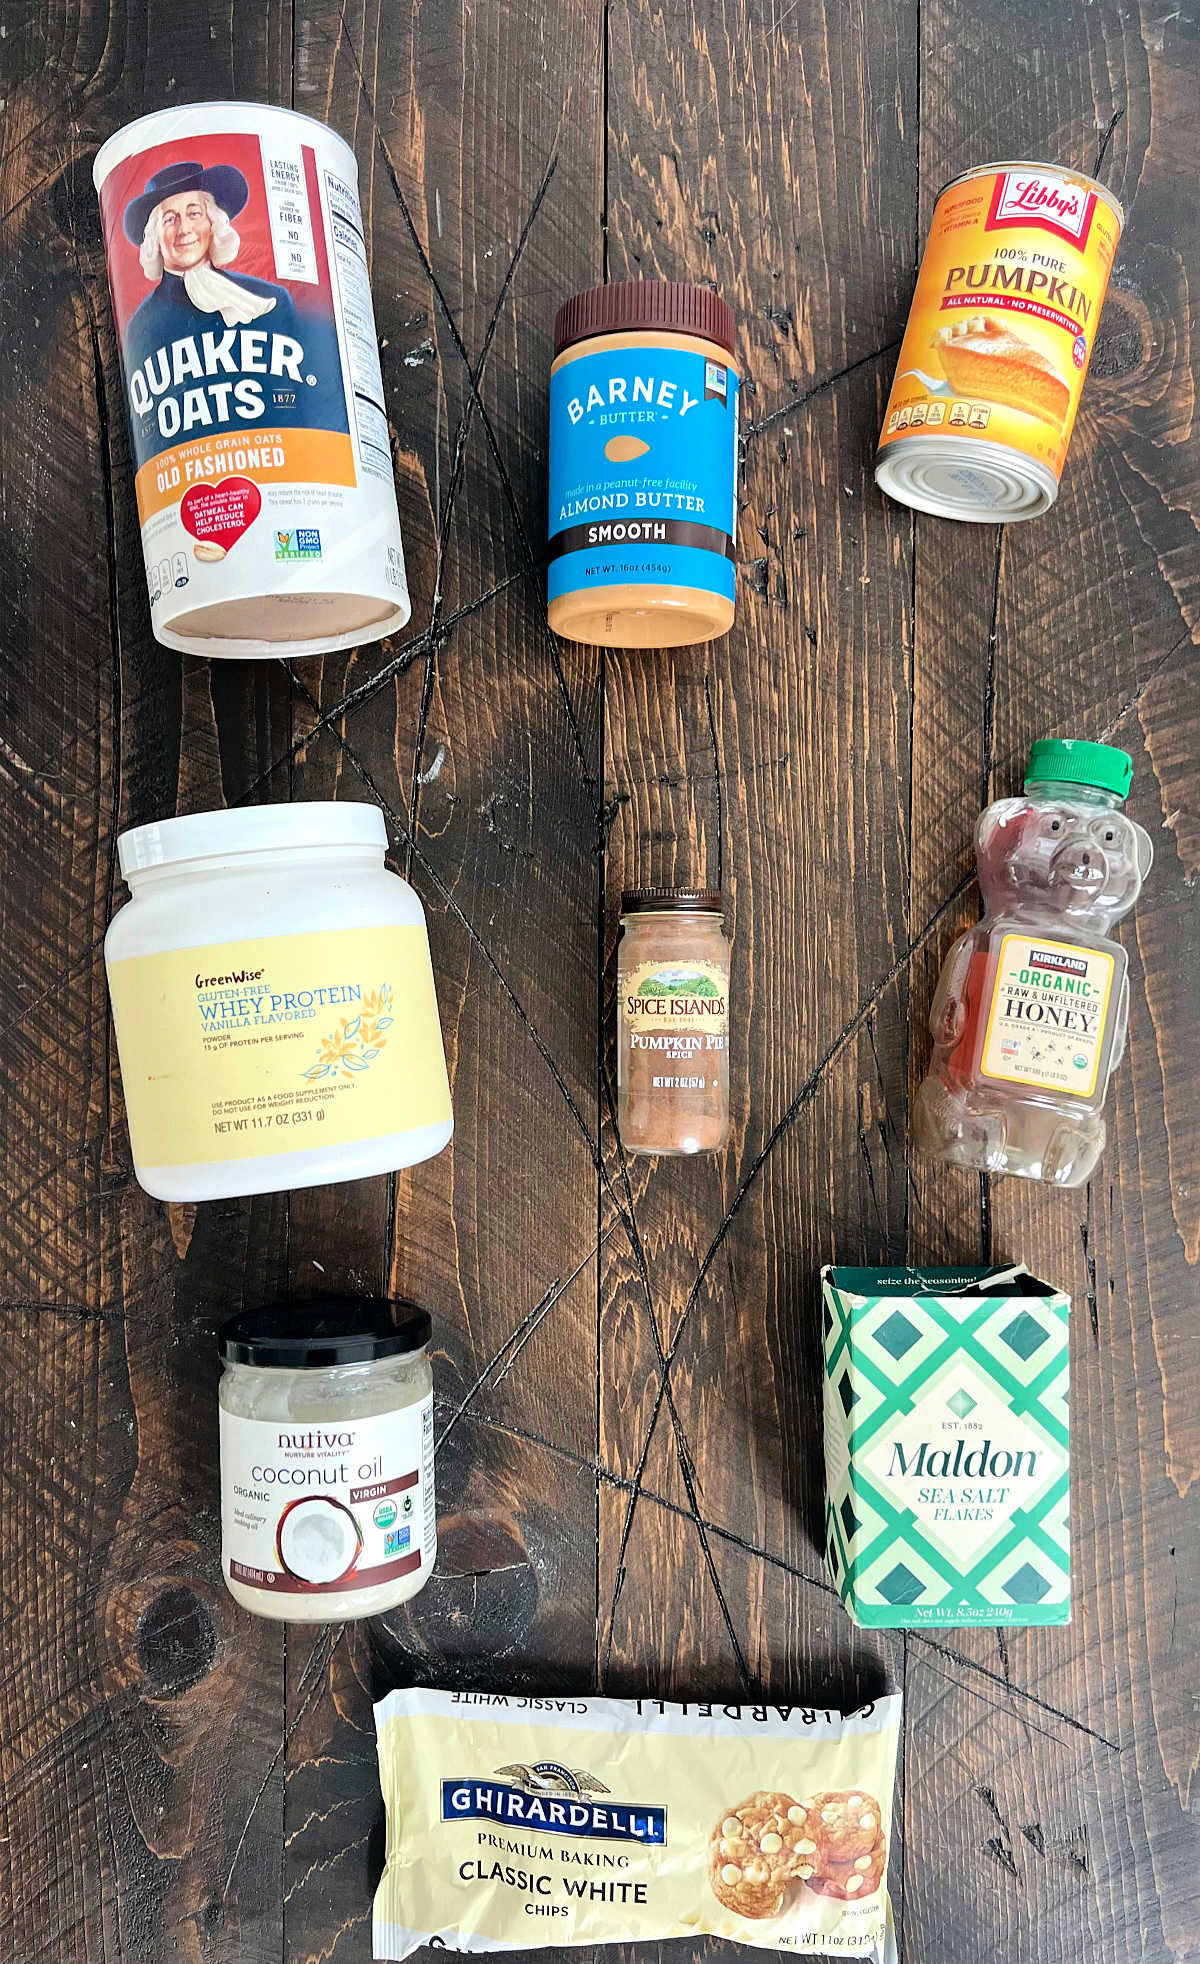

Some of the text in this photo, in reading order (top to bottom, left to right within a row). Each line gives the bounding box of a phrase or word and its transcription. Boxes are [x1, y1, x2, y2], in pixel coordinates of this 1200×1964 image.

[270, 160, 299, 173] LASTING
[271, 169, 300, 183] ENERGY
[1005, 180, 1079, 218] Libby's
[280, 212, 302, 225] FIBER
[288, 230, 299, 241] NO
[291, 253, 302, 263] NO
[994, 247, 1067, 274] 100% PURE
[944, 264, 1092, 324] PUMPKIN
[947, 295, 1080, 335] ALL NATURAL NO PRESERVATIVES
[130, 329, 304, 419] QUAKER
[157, 379, 266, 438] OATS
[272, 393, 297, 405] 1877
[567, 376, 699, 425] BARNEY
[600, 410, 656, 426] BUTTER
[155, 433, 283, 470] 100% WHOLE GRAIN OATS
[157, 447, 285, 493] OLD FASHIONED
[586, 482, 595, 493] in
[596, 482, 602, 491] a
[602, 477, 663, 492] peanut-free
[664, 478, 698, 492] facility
[194, 502, 244, 519] OATMEAL CAN
[559, 492, 705, 520] ALMOND BUTTER
[195, 511, 245, 529] HELP REDUCE
[196, 519, 246, 536] CHOLESTEROL
[298, 530, 318, 538] NON
[299, 537, 320, 545] GMO
[588, 523, 666, 543] SMOOTH
[585, 566, 600, 576] NET
[620, 564, 639, 572] 16oz
[641, 563, 672, 574] (454g)
[1032, 951, 1087, 971] KIRKLAND
[195, 969, 262, 989] GreenWise
[1019, 969, 1092, 998] ORGANIC
[197, 984, 271, 1003] GLUTEN-FREE
[198, 984, 362, 1021] WHEY PROTEIN
[1007, 986, 1099, 1013] RAW & UNFILTERED
[627, 996, 725, 1015] SPICE ISLANDS
[201, 1008, 317, 1032] VANILLA FLAVORED
[1004, 998, 1096, 1034] HONEY
[202, 1034, 231, 1044] POWDER
[230, 1039, 259, 1048] PROTEIN
[275, 1031, 305, 1042] SERVING
[630, 1034, 724, 1050] PUMPKIN PIE
[666, 1050, 693, 1059] SPICE
[652, 1076, 663, 1088] NET
[664, 1076, 674, 1088] WT
[211, 1101, 223, 1109] USE
[225, 1097, 255, 1107] PRODUCT
[273, 1092, 294, 1100] FOOD
[295, 1085, 337, 1097] SUPPLEMENT
[239, 1105, 252, 1113] USE
[268, 1099, 294, 1108] WEIGHT
[214, 1108, 325, 1134] NET WT 11.7 OZ (331 g)
[877, 1277, 902, 1285] seize
[904, 1277, 920, 1285] the
[941, 1422, 983, 1431] EST. 1882
[278, 1430, 354, 1449] nutiva
[317, 1450, 345, 1458] VITALITY
[885, 1440, 1038, 1478] Maldon
[251, 1455, 383, 1485] coconut oil
[233, 1485, 270, 1502] ORGANIC
[353, 1485, 387, 1500] VIRGIN
[917, 1488, 1010, 1504] SEA SALT
[933, 1508, 994, 1521] FLAKES
[915, 1607, 933, 1617] Net
[986, 1606, 1014, 1618] 240g
[451, 1691, 588, 1714] CLASSIC WHITE
[636, 1699, 876, 1725] GIRARDELLI
[550, 1764, 576, 1790] FRANCISCO
[452, 1788, 658, 1837] GHIRARDELLI
[477, 1833, 630, 1868] PREMIUM BAKING
[459, 1860, 648, 1904] CLASSIC WHITE
[524, 1903, 569, 1917] CHIPS
[801, 1932, 818, 1945] WT
